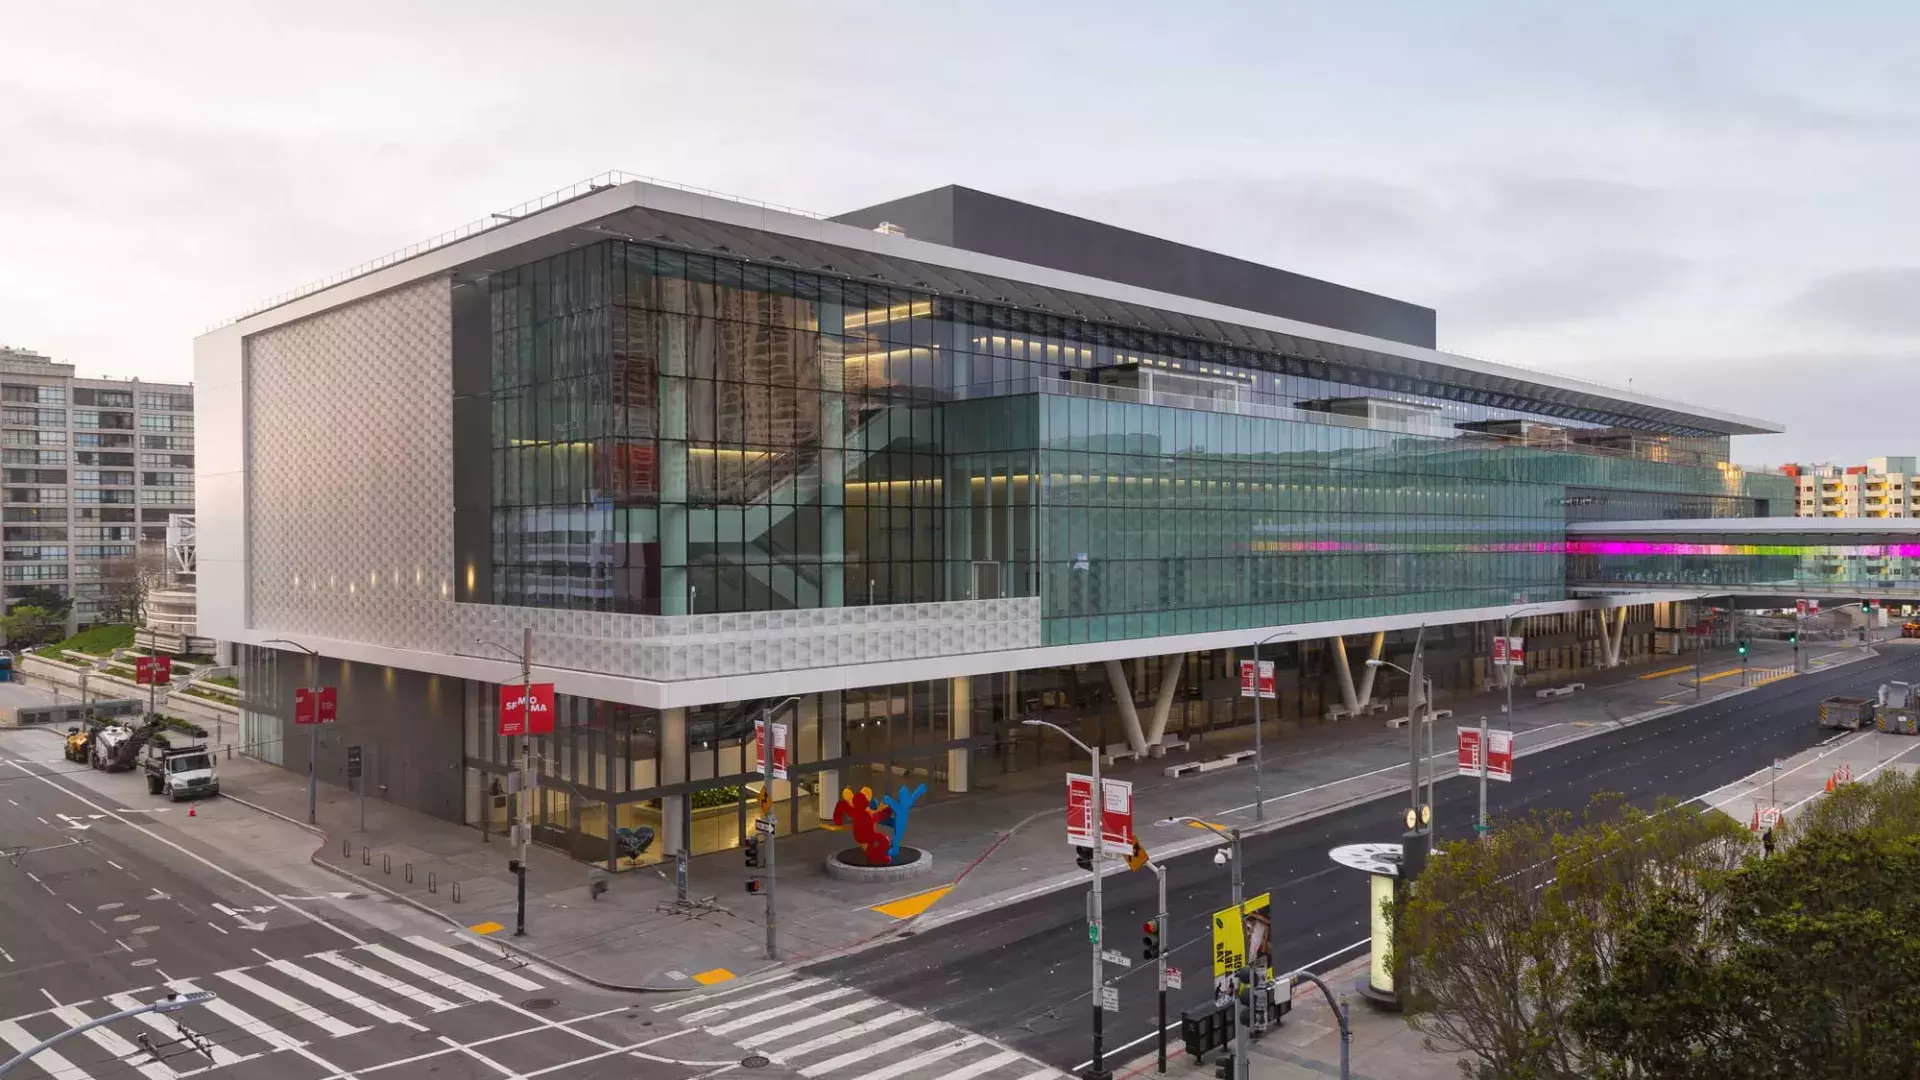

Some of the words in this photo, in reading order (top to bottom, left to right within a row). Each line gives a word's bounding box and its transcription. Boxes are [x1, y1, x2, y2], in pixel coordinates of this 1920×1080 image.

[506, 702, 517, 711] SF
[530, 704, 547, 712] MA
[1216, 942, 1224, 963] BAY
[1225, 950, 1233, 978] AREA
